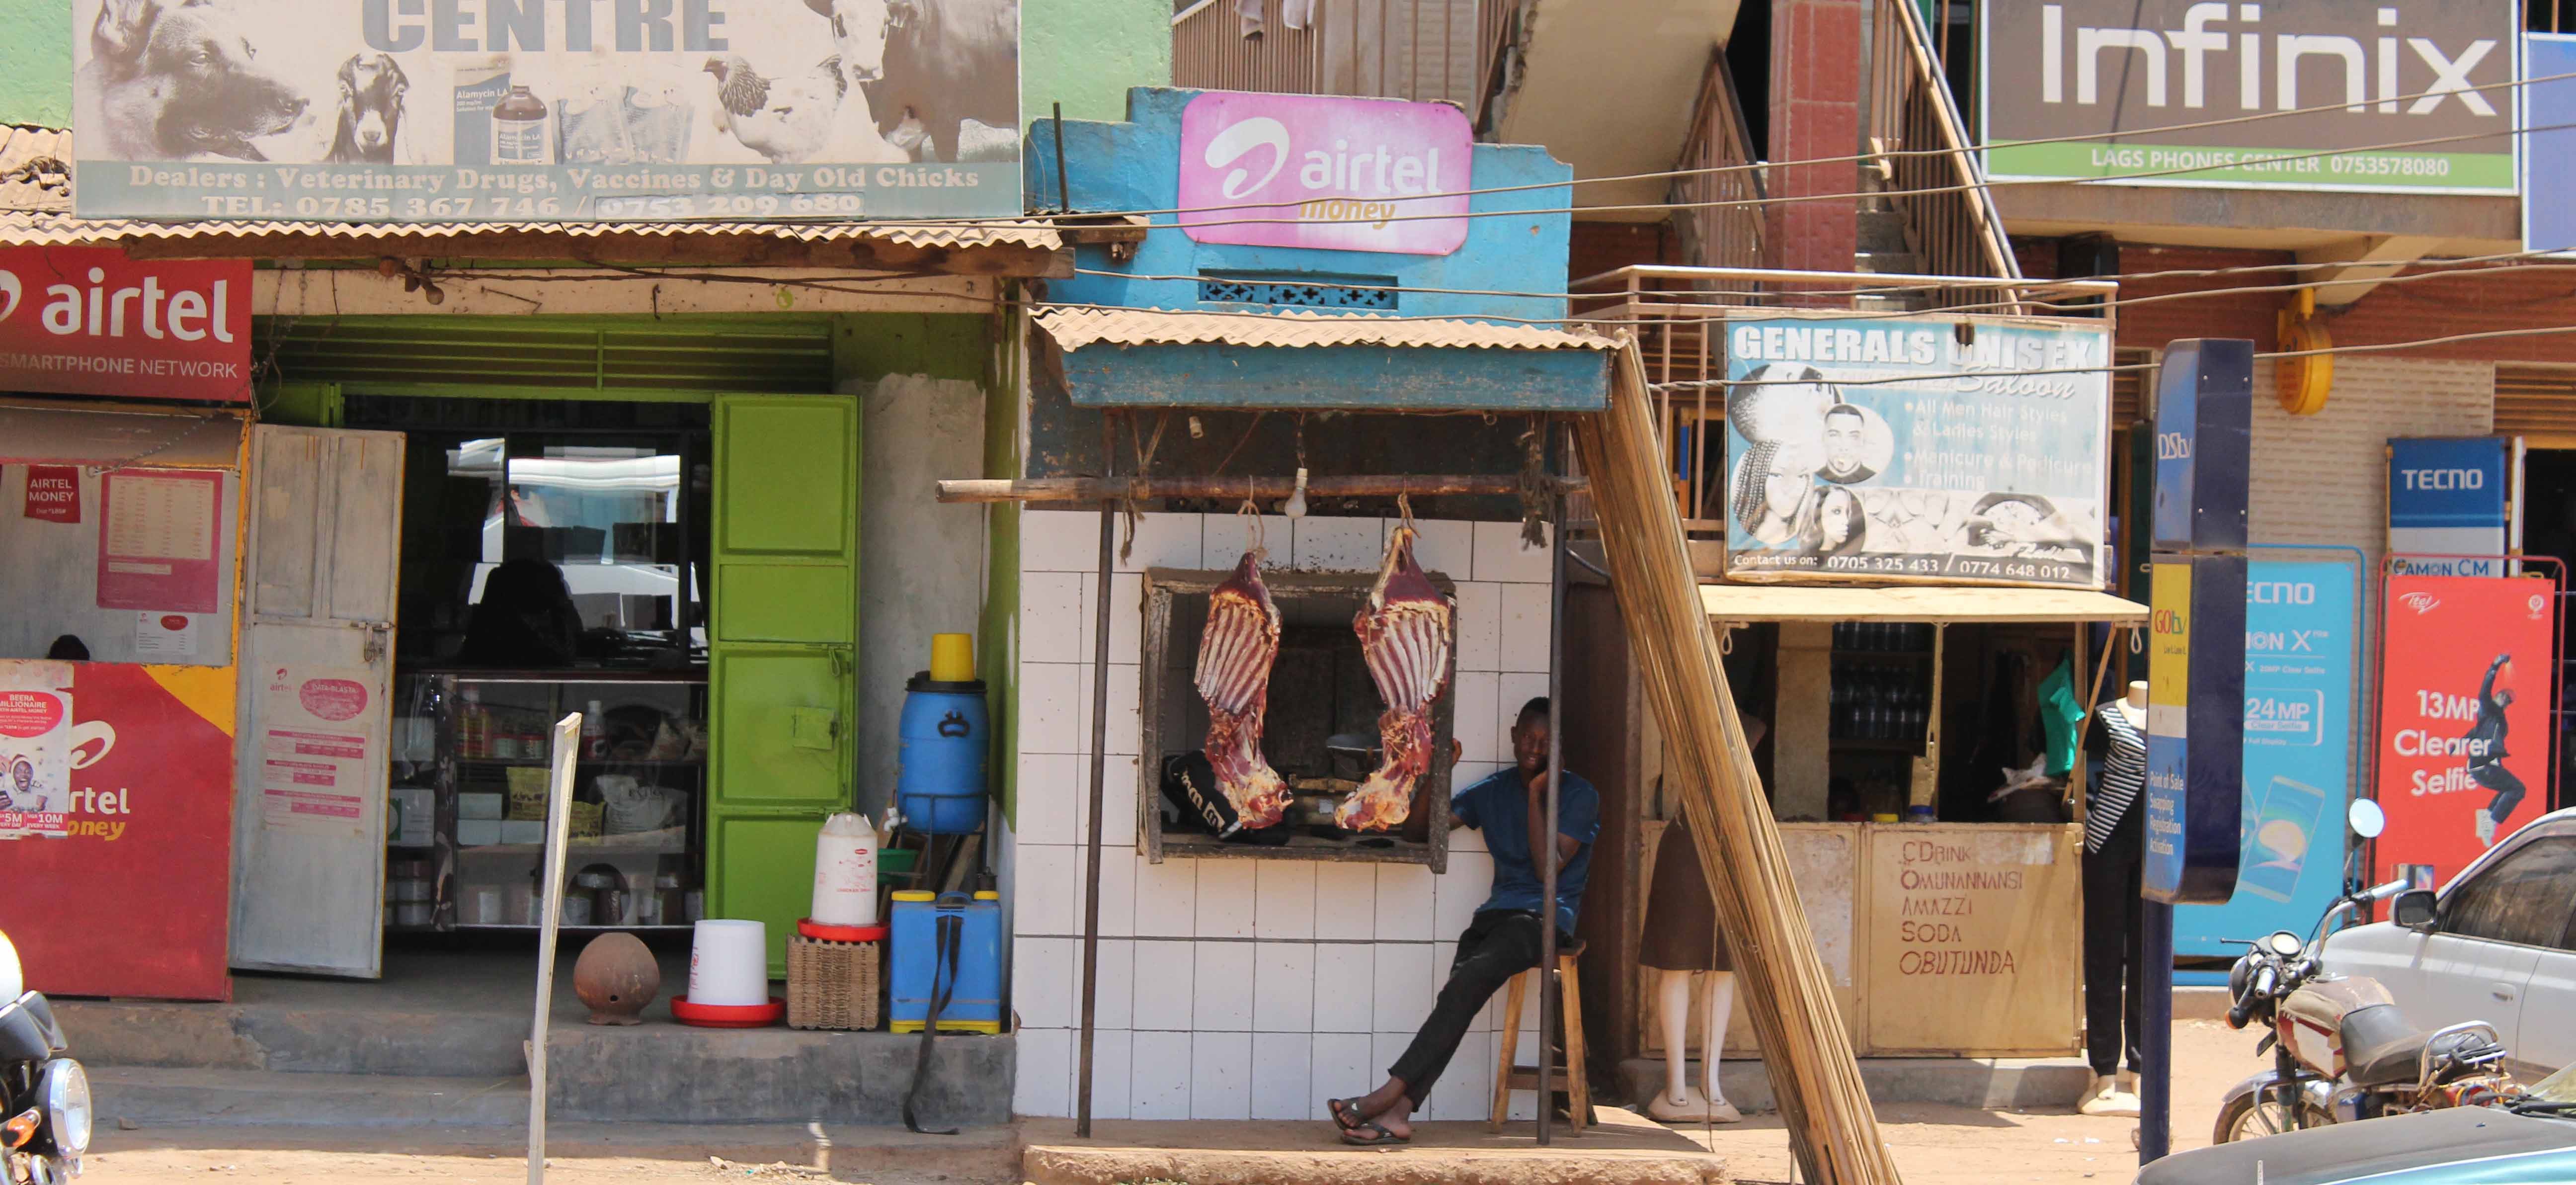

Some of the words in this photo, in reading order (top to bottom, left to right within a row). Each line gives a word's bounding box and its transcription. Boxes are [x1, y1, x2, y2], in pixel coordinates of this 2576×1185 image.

[362, 0, 729, 52] CENTRE
[2042, 2, 2497, 117] Infinix
[1299, 139, 1443, 194] airtel
[2091, 148, 2144, 168] LAGS
[2150, 150, 2235, 170] PHONES
[2240, 152, 2321, 173] CENTER
[2330, 155, 2449, 176] 0753578080
[130, 165, 248, 189] Dealers
[275, 168, 443, 193] Veterinary
[456, 169, 557, 194] Drugs,
[567, 168, 701, 190] Vaccines
[710, 168, 735, 189] &
[745, 168, 803, 193] Day
[812, 167, 866, 188] Old
[876, 167, 979, 188] Chicks
[201, 195, 283, 217] TEL:
[296, 195, 391, 217] 0785
[405, 195, 483, 217] 367
[494, 195, 560, 217] 746
[600, 197, 695, 217] 0753
[707, 196, 779, 215] 209
[790, 194, 861, 214] 680
[1299, 199, 1396, 230] money
[42, 266, 234, 343] airtel
[1734, 325, 1938, 365] GENERALS
[1946, 329, 2093, 374] UNISEX
[0, 352, 135, 374] SMARTPHONE
[139, 359, 238, 379] NETWORK
[1955, 361, 2076, 399] Saloon
[1915, 400, 1936, 415] All
[1942, 401, 1976, 417] Men
[1982, 402, 2013, 420] Hair
[2019, 405, 2067, 425] Styles
[1932, 422, 1984, 439] Ladies
[1990, 424, 2037, 443] Styles
[2017, 453, 2093, 475] Pedicure
[30, 479, 72, 489] AIRTEL
[1919, 470, 1986, 491] Training
[2401, 468, 2484, 490] TECNO
[29, 491, 74, 502] MONEY
[1734, 554, 1781, 568] Contact
[1784, 556, 1797, 567] us
[1827, 555, 1868, 570] 0705
[1875, 557, 1904, 572] 325
[1909, 558, 1939, 573] 433
[1959, 560, 2001, 576] 0774
[2006, 562, 2036, 578] 648
[2040, 565, 2071, 580] 012
[2458, 559, 2489, 576] CM
[2246, 631, 2284, 651] ON
[2290, 629, 2312, 652] X
[2416, 689, 2480, 722] 13MP
[2393, 729, 2492, 757] Clearer
[2170, 773, 2184, 791] Sale
[2410, 767, 2478, 797] Selfie
[38, 814, 64, 824] 10M
[1902, 896, 1972, 916] AMAZZI
[1901, 920, 1962, 943] SODA
[1899, 949, 2015, 976] OBUTUNDA
